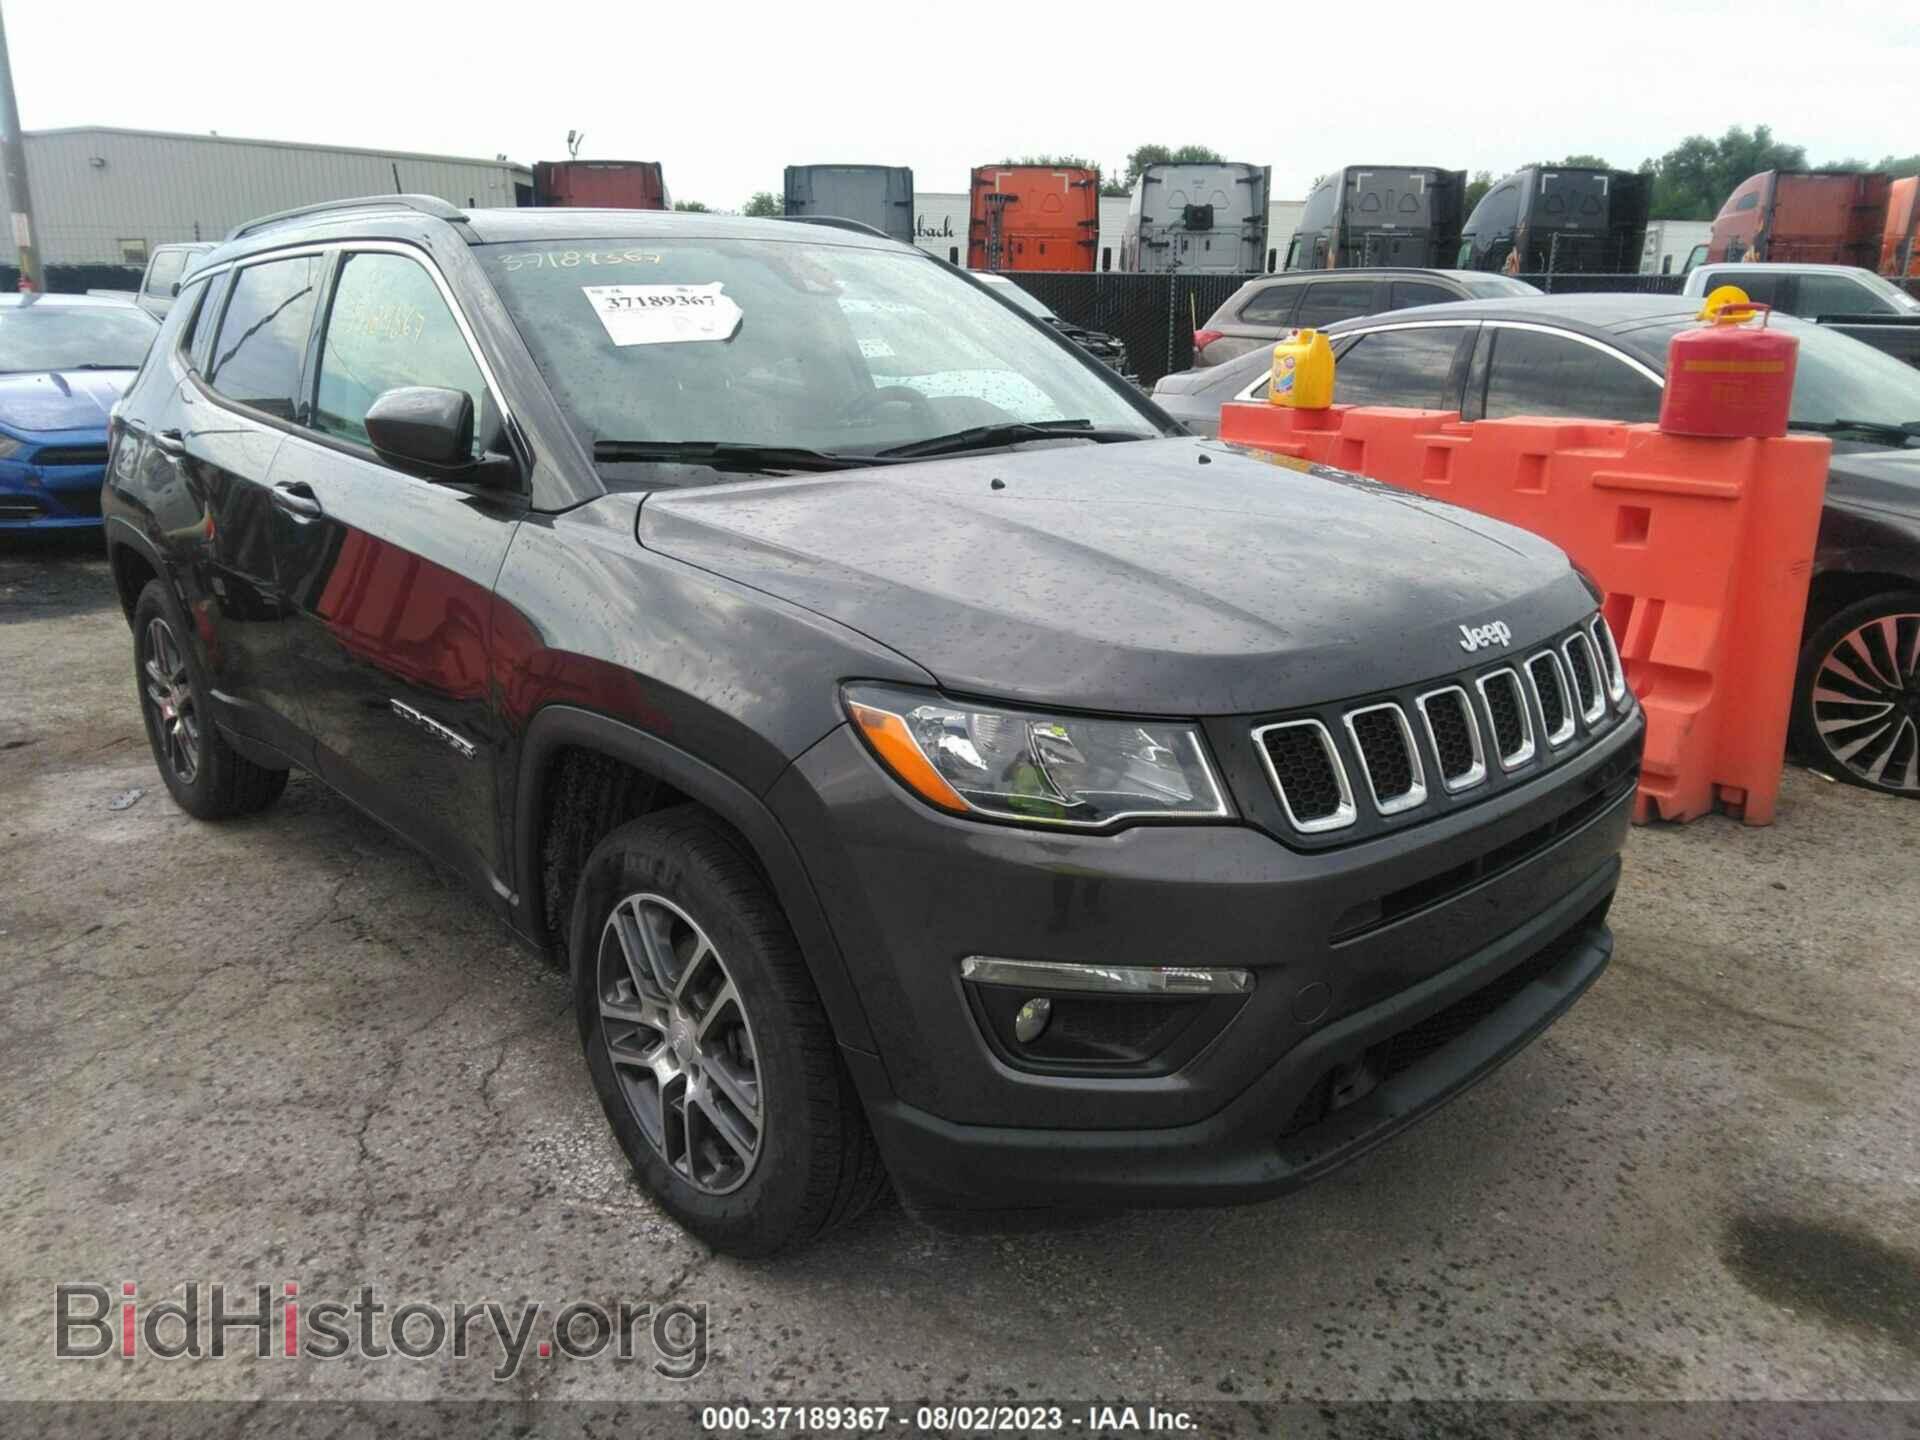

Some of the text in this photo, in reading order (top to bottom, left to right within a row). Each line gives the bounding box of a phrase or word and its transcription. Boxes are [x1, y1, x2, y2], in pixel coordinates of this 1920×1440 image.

[913, 215, 956, 238] bach
[604, 295, 716, 309] 37189367
[1458, 620, 1512, 652] Jeep
